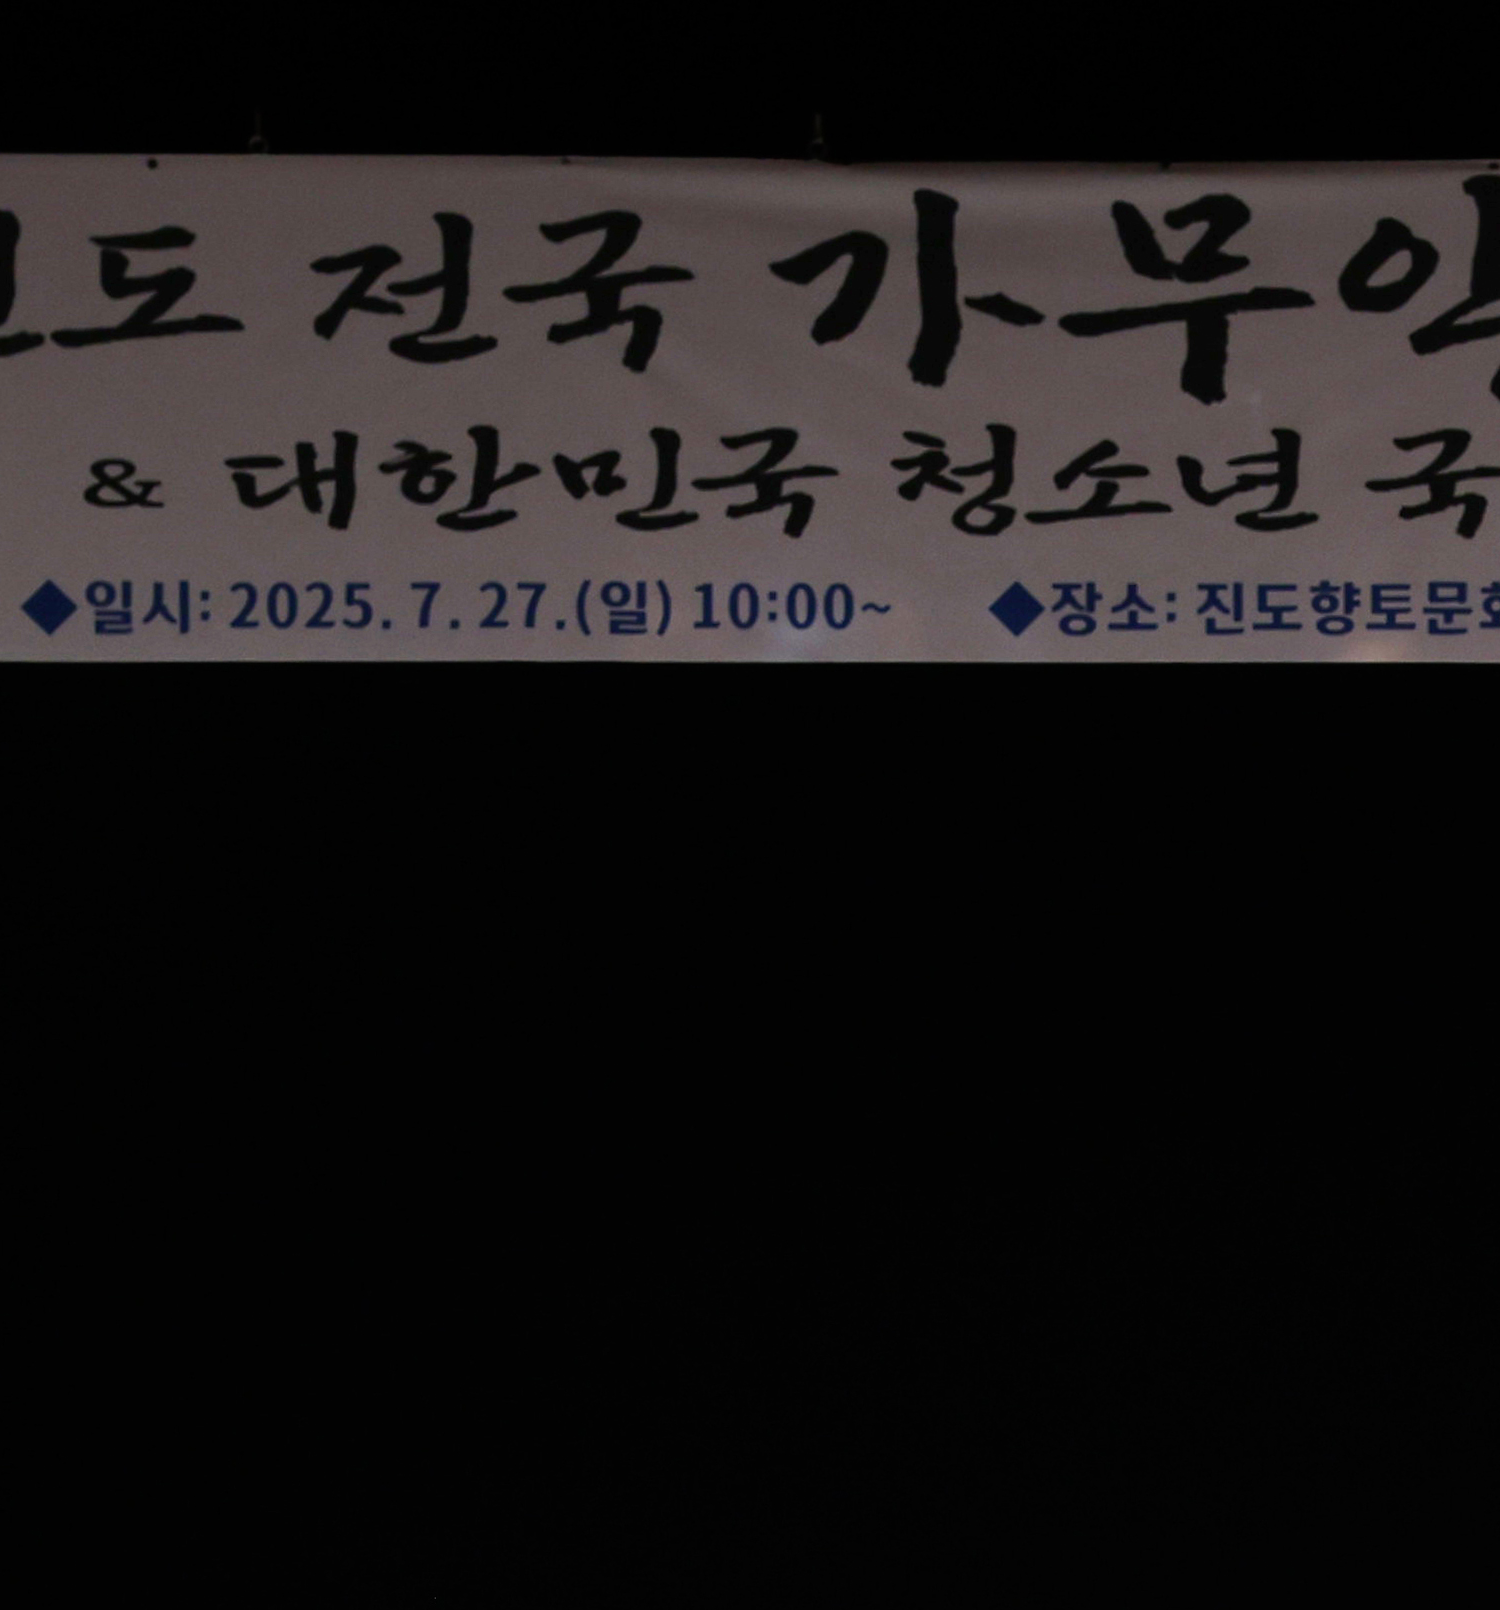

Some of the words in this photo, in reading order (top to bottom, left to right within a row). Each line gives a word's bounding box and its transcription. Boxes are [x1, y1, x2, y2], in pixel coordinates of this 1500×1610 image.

[309, 208, 696, 374] 전국
[83, 458, 165, 509] &
[223, 424, 840, 539] 대한민국
[889, 422, 1320, 537] 청소년
[84, 579, 211, 636] 일시:
[229, 581, 392, 630] 2025.
[1051, 581, 1177, 637] 장소:
